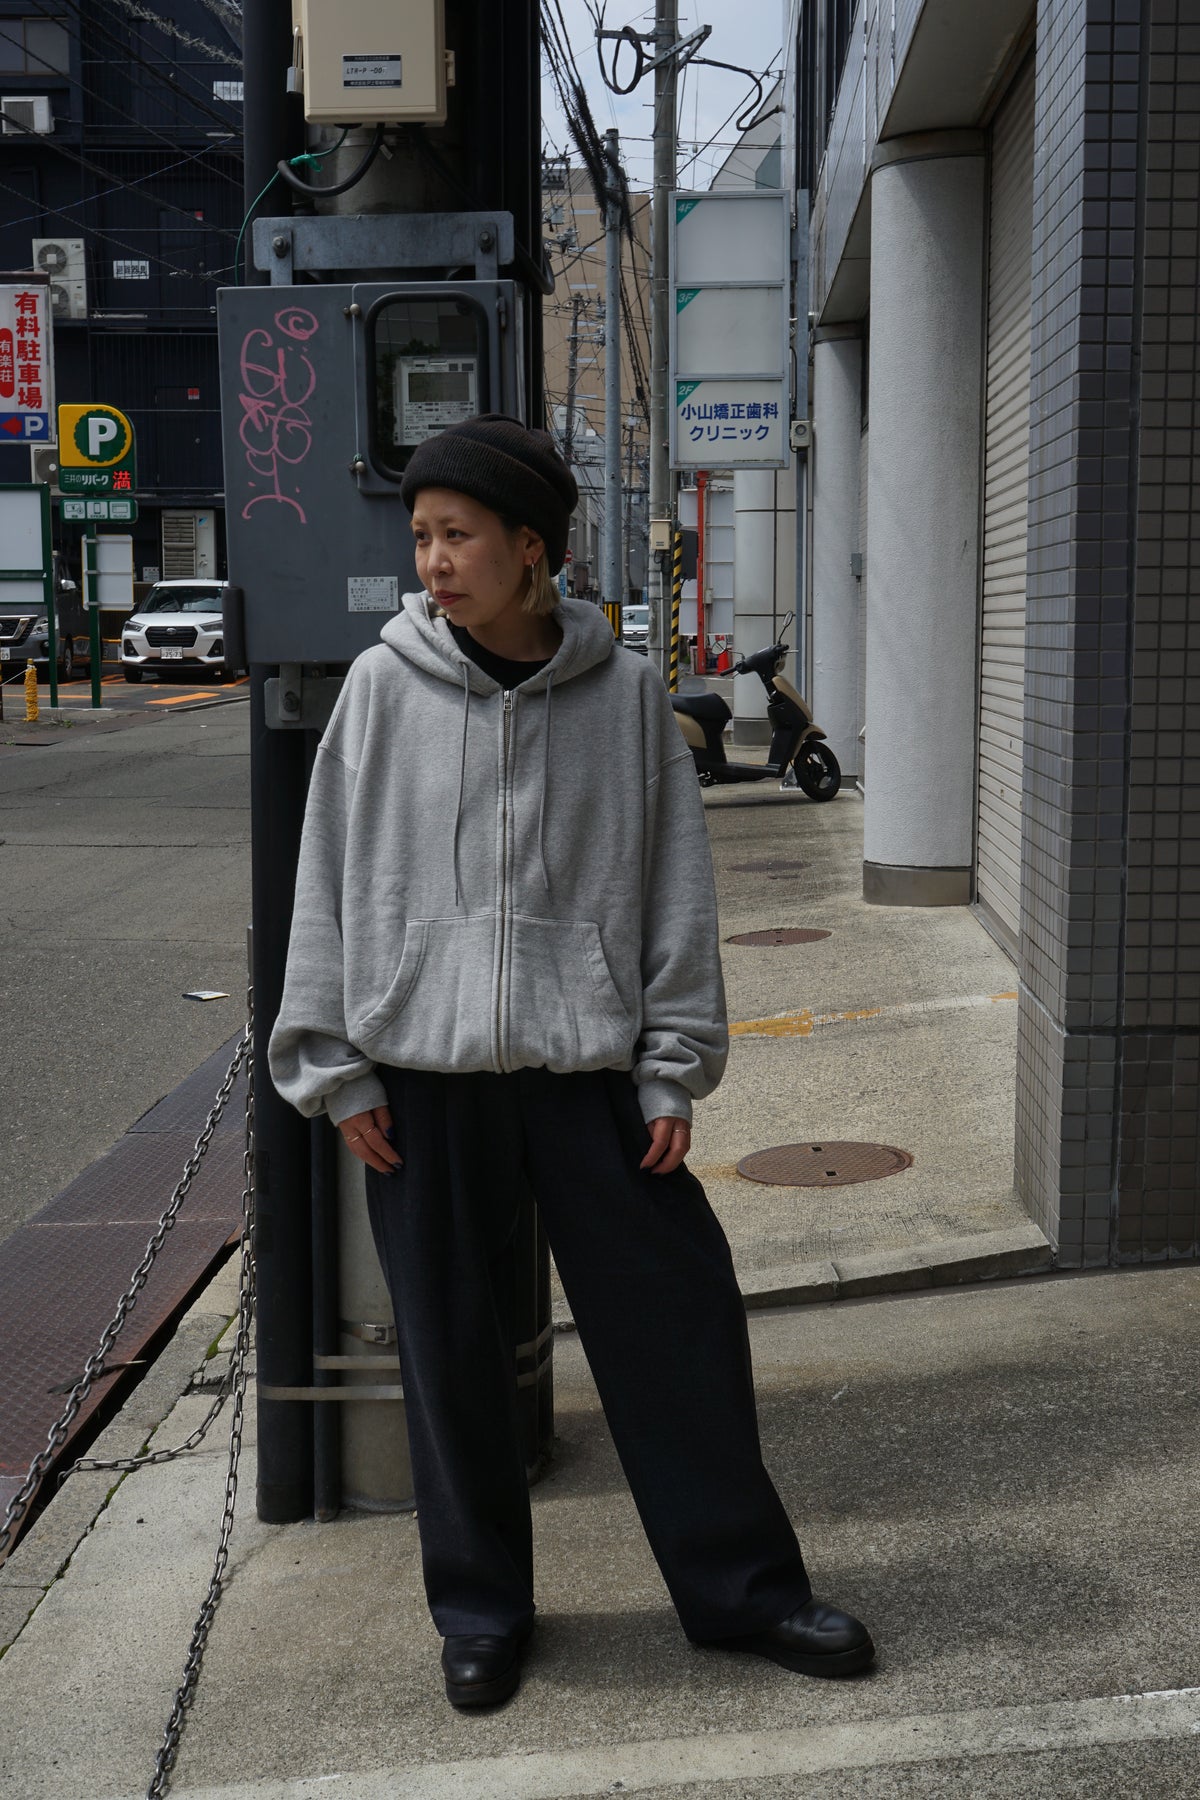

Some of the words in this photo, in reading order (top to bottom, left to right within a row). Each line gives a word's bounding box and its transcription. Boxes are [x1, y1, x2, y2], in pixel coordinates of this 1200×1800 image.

[678, 202, 693, 213] 4F
[678, 293, 694, 303] 3F
[15, 292, 42, 409] 有料駐車場
[678, 385, 694, 395] 2F
[681, 403, 778, 420] 小山矯正歯科
[25, 416, 44, 437] P
[690, 425, 769, 441] クリニック
[88, 417, 118, 456] P
[64, 474, 109, 485] 三井のリパーク
[113, 471, 131, 490] 満
